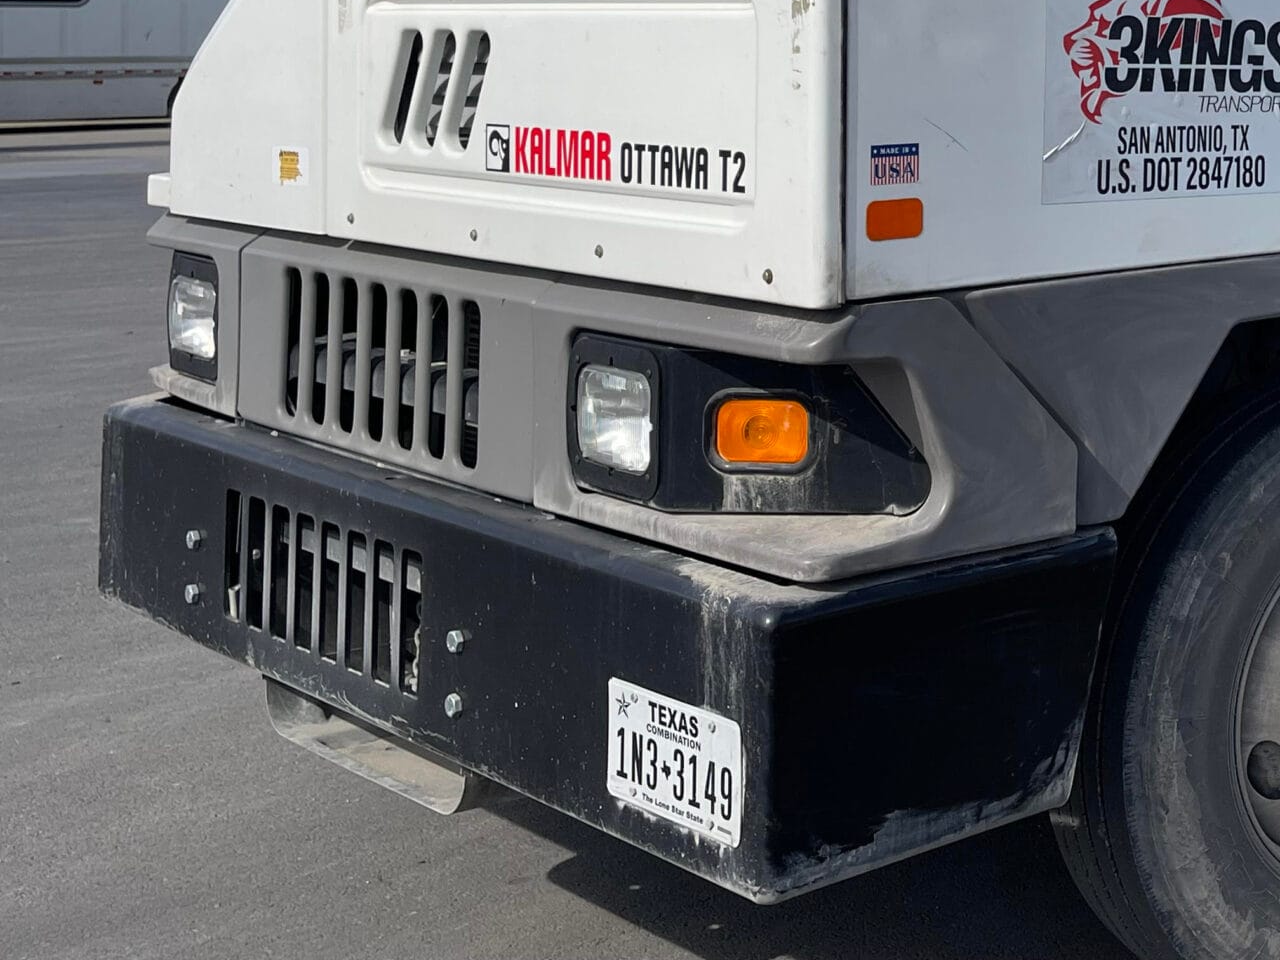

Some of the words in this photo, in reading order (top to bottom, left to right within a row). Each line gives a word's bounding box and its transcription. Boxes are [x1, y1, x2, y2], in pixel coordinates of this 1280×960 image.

[1117, 126, 1150, 155] SAN
[1154, 124, 1227, 155] ANTONIO,
[1231, 124, 1250, 151] TX
[515, 126, 612, 182] KALMAR
[620, 142, 708, 190] OTTAWA
[719, 149, 746, 193] T2
[874, 162, 915, 179] USA
[1097, 158, 1136, 194] U.S.
[1142, 157, 1182, 192] DOT
[1186, 155, 1266, 190] 2847180
[648, 700, 699, 738] TEXAS
[646, 724, 701, 751] COMBINATION
[642, 793, 653, 805] The
[655, 799, 670, 811] Lone
[672, 805, 684, 816] Star
[686, 811, 703, 824] State
